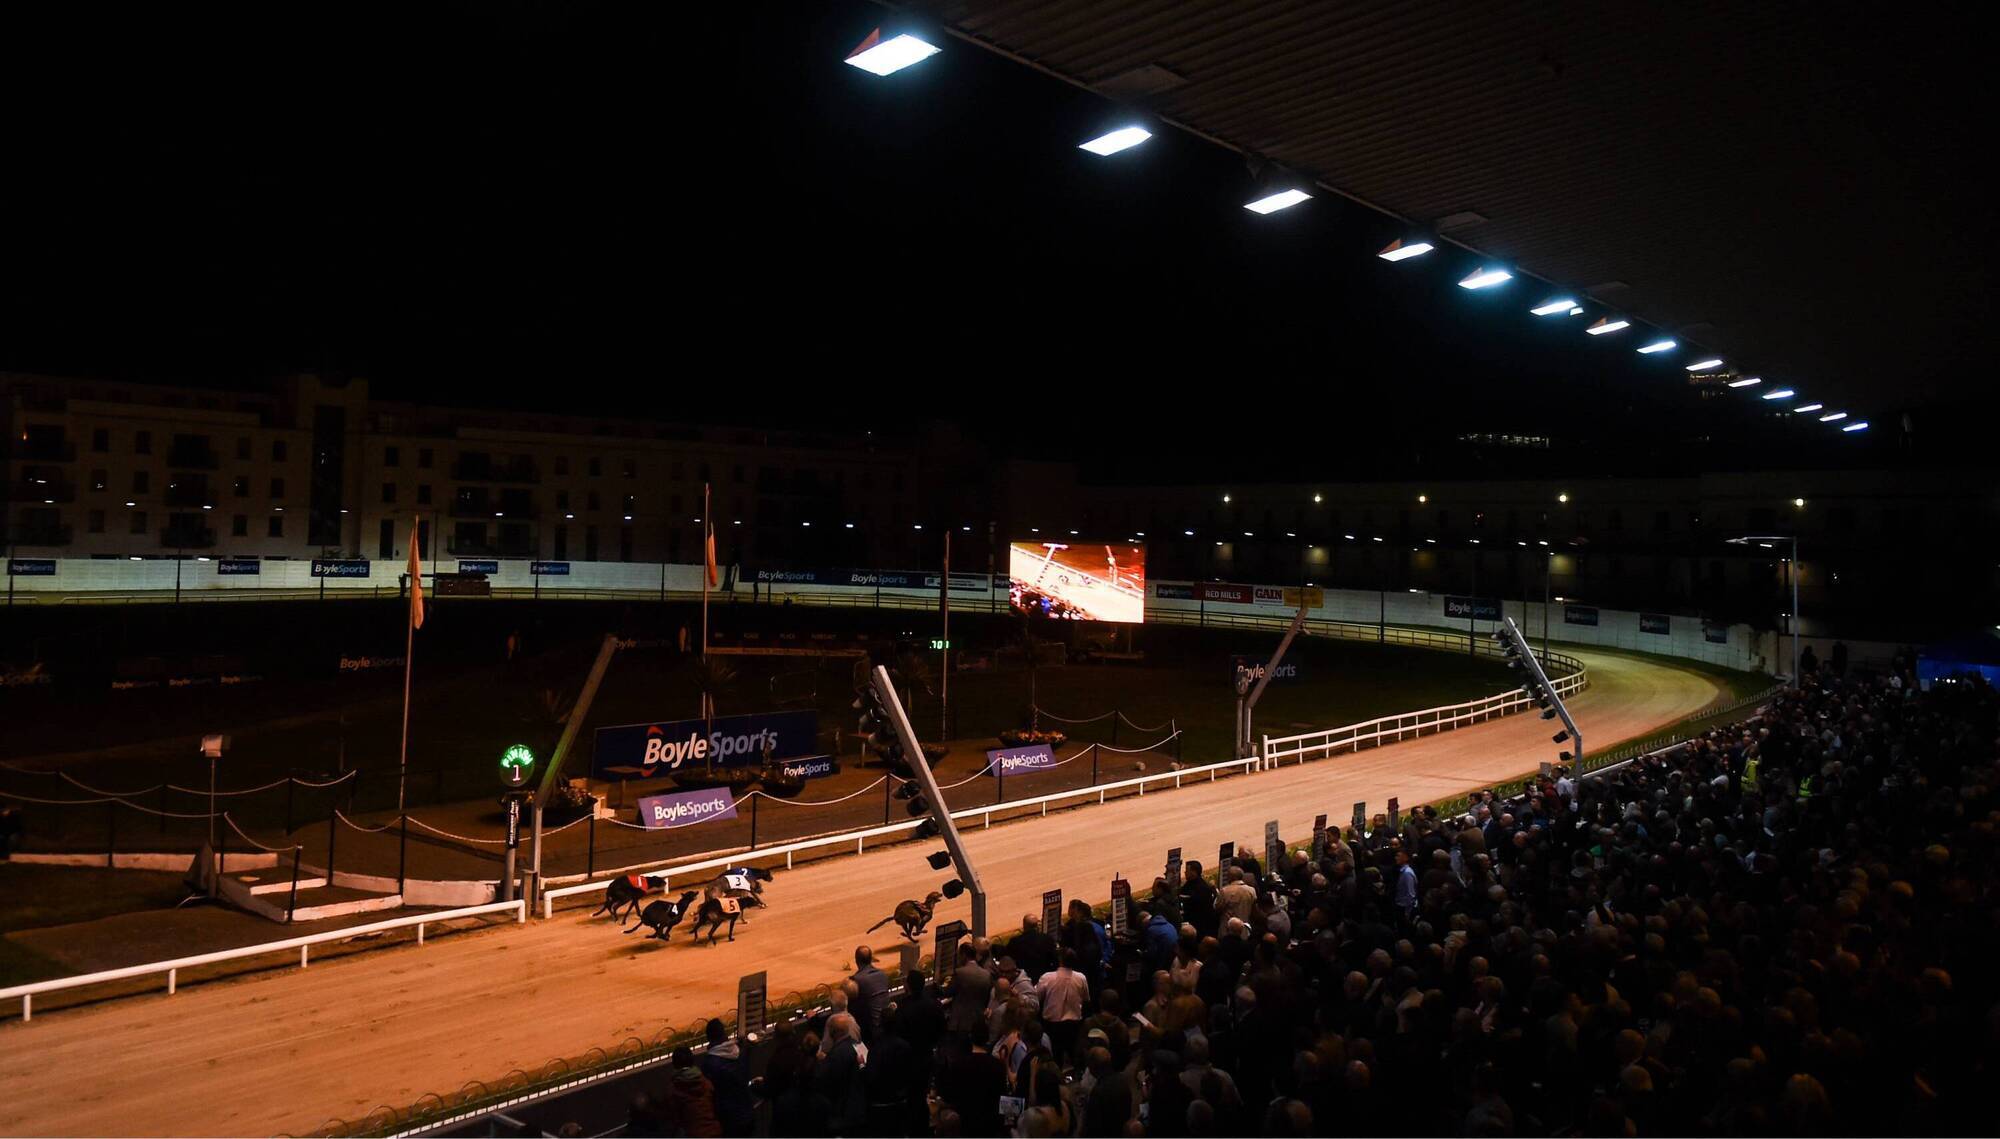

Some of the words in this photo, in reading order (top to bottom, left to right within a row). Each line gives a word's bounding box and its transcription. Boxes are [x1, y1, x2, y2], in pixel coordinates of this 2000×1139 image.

[1205, 590, 1219, 598] RED
[1220, 591, 1241, 600] MILLS
[1255, 588, 1283, 600] GAIN
[643, 727, 778, 769] BoyleSports
[512, 764, 521, 781] 1
[654, 798, 725, 822] BoyleSports
[735, 877, 741, 886] 3
[671, 904, 678, 915] 4
[729, 901, 735, 911] 5
